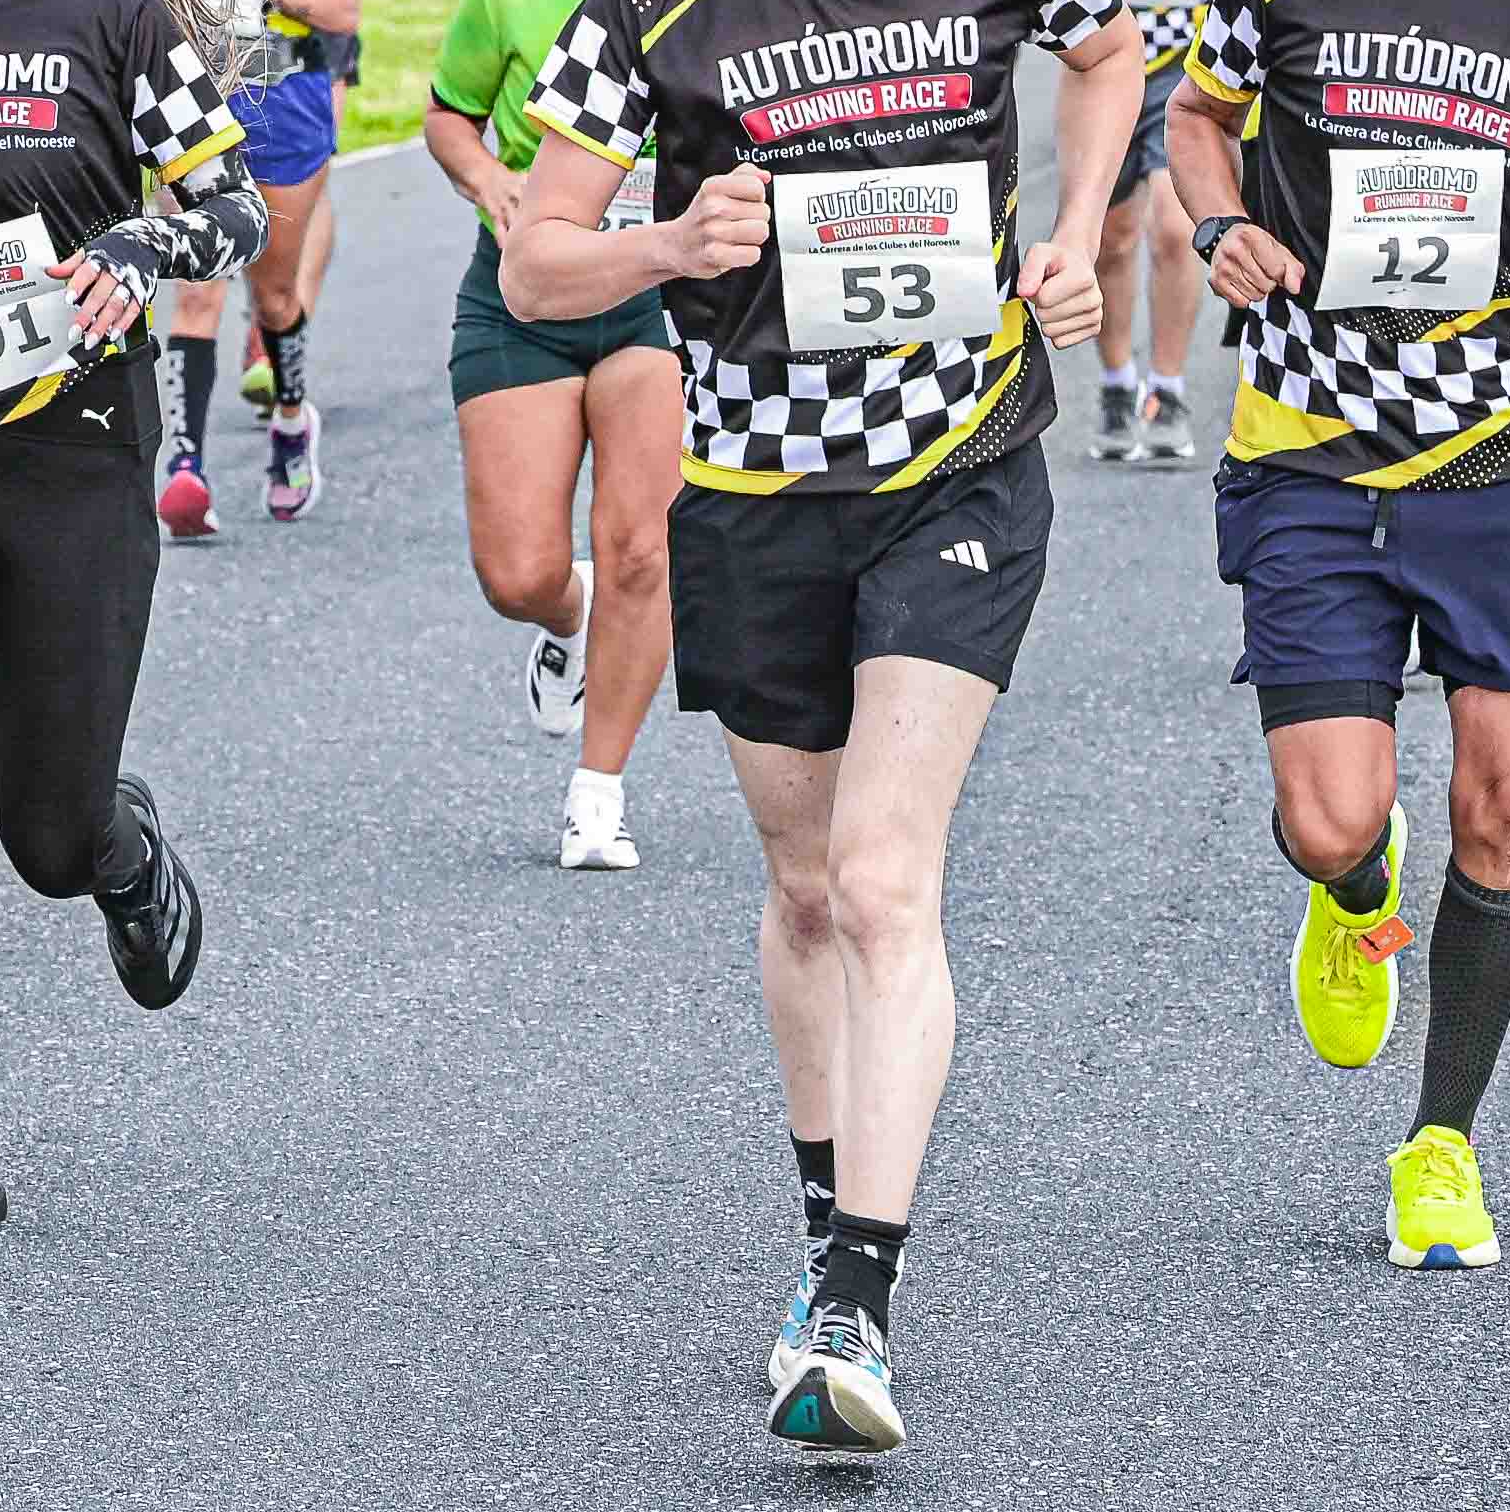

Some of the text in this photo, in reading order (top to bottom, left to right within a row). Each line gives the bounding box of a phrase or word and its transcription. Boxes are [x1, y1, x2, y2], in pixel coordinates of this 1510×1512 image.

[717, 15, 980, 109] AUTÓDROMO
[766, 81, 947, 136] RUNNING RACE
[1346, 87, 1448, 122] RUNNING
[14, 134, 76, 149] Noroeste
[735, 109, 988, 163] La Carrera de los Clubes del Noroeste
[1305, 112, 1316, 128] La
[1319, 117, 1368, 139] Carrera
[1371, 128, 1389, 143] de
[1392, 130, 1412, 148] los
[1357, 159, 1477, 194] AUTÓDROMO
[807, 181, 957, 225] AUTÓDROMO
[1374, 193, 1454, 210] RUNNING RACE
[820, 245, 851, 254] Carrera
[865, 243, 877, 251] los
[879, 241, 907, 250] Clubes
[909, 240, 921, 248] del
[923, 239, 960, 248] Noroeste
[832, 216, 934, 241] RUNNING RACE
[1372, 236, 1449, 285] 12
[842, 264, 936, 323] 53
